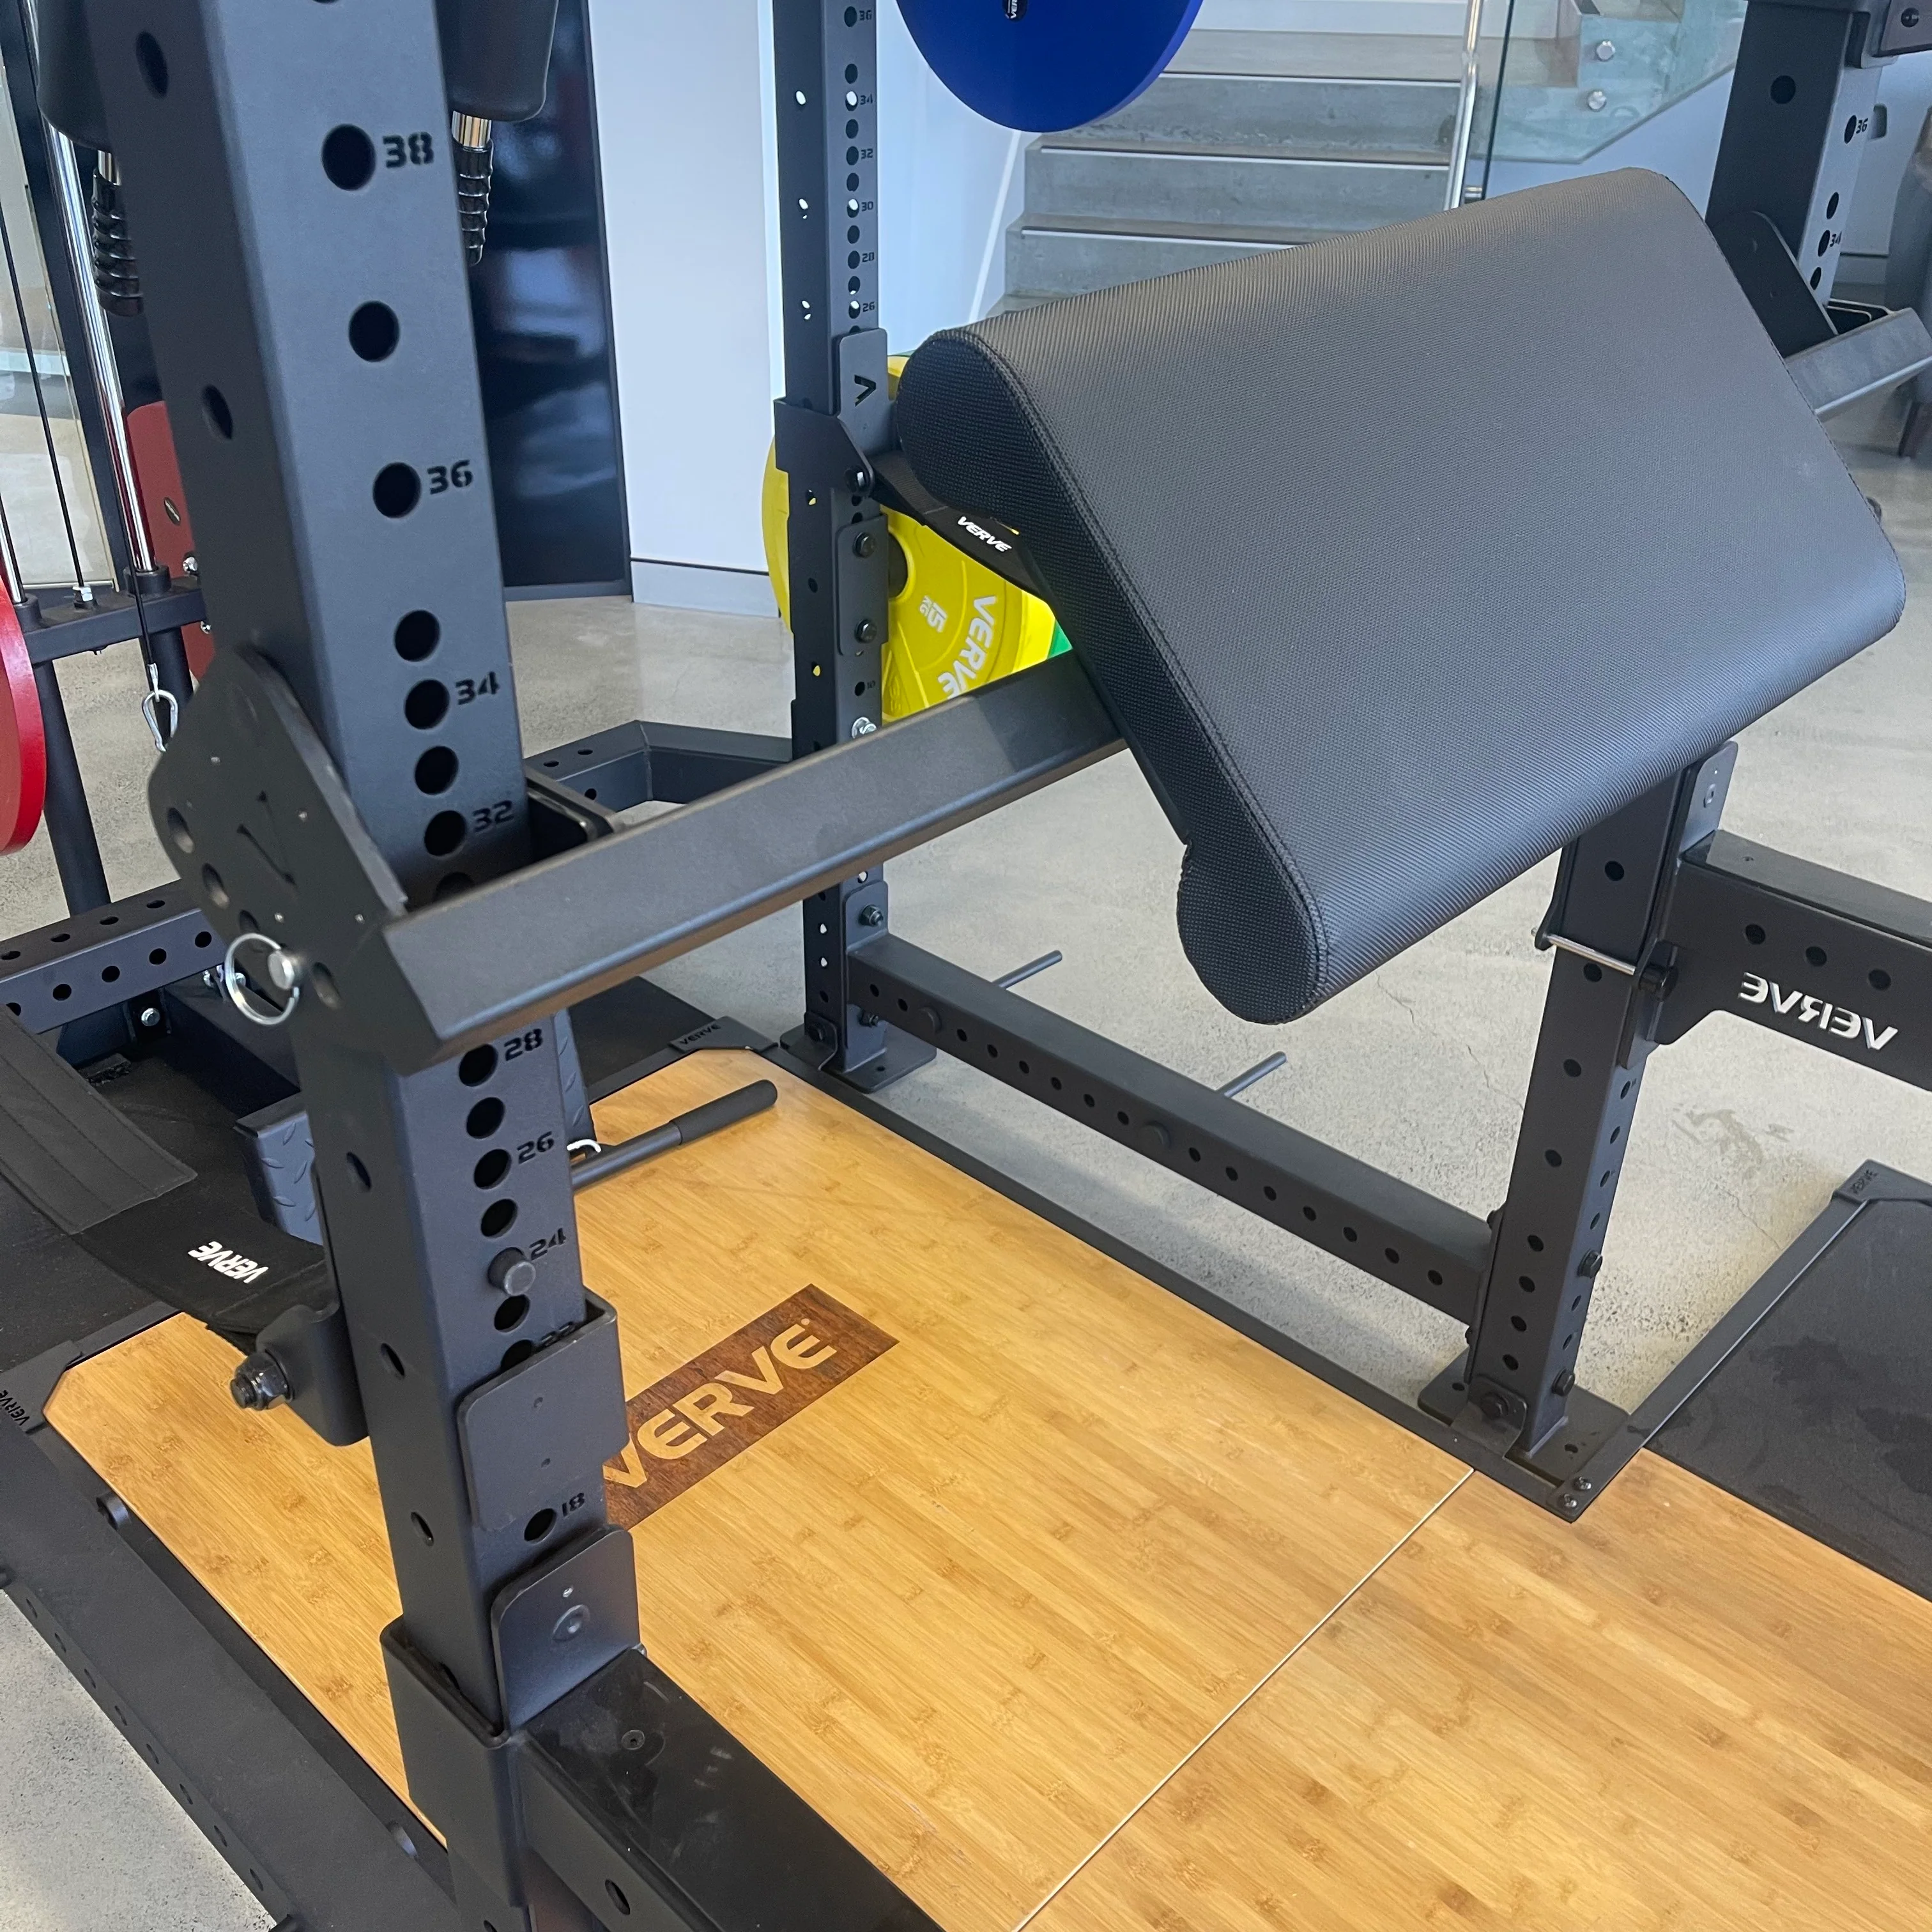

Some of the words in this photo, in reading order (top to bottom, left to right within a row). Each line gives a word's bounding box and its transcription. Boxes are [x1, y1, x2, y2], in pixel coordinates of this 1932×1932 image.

[382, 131, 435, 169] 38
[861, 148, 874, 160] 32
[861, 201, 874, 212] 30
[862, 301, 875, 312] 26
[427, 459, 474, 496] 36
[958, 516, 1013, 553] VERVE
[456, 671, 500, 705] 34
[472, 799, 513, 832] 32
[505, 1029, 542, 1062] 28
[518, 1131, 555, 1165] 26
[529, 1228, 567, 1260] 24
[187, 1241, 270, 1284] VERVE
[561, 1492, 586, 1518] 18
